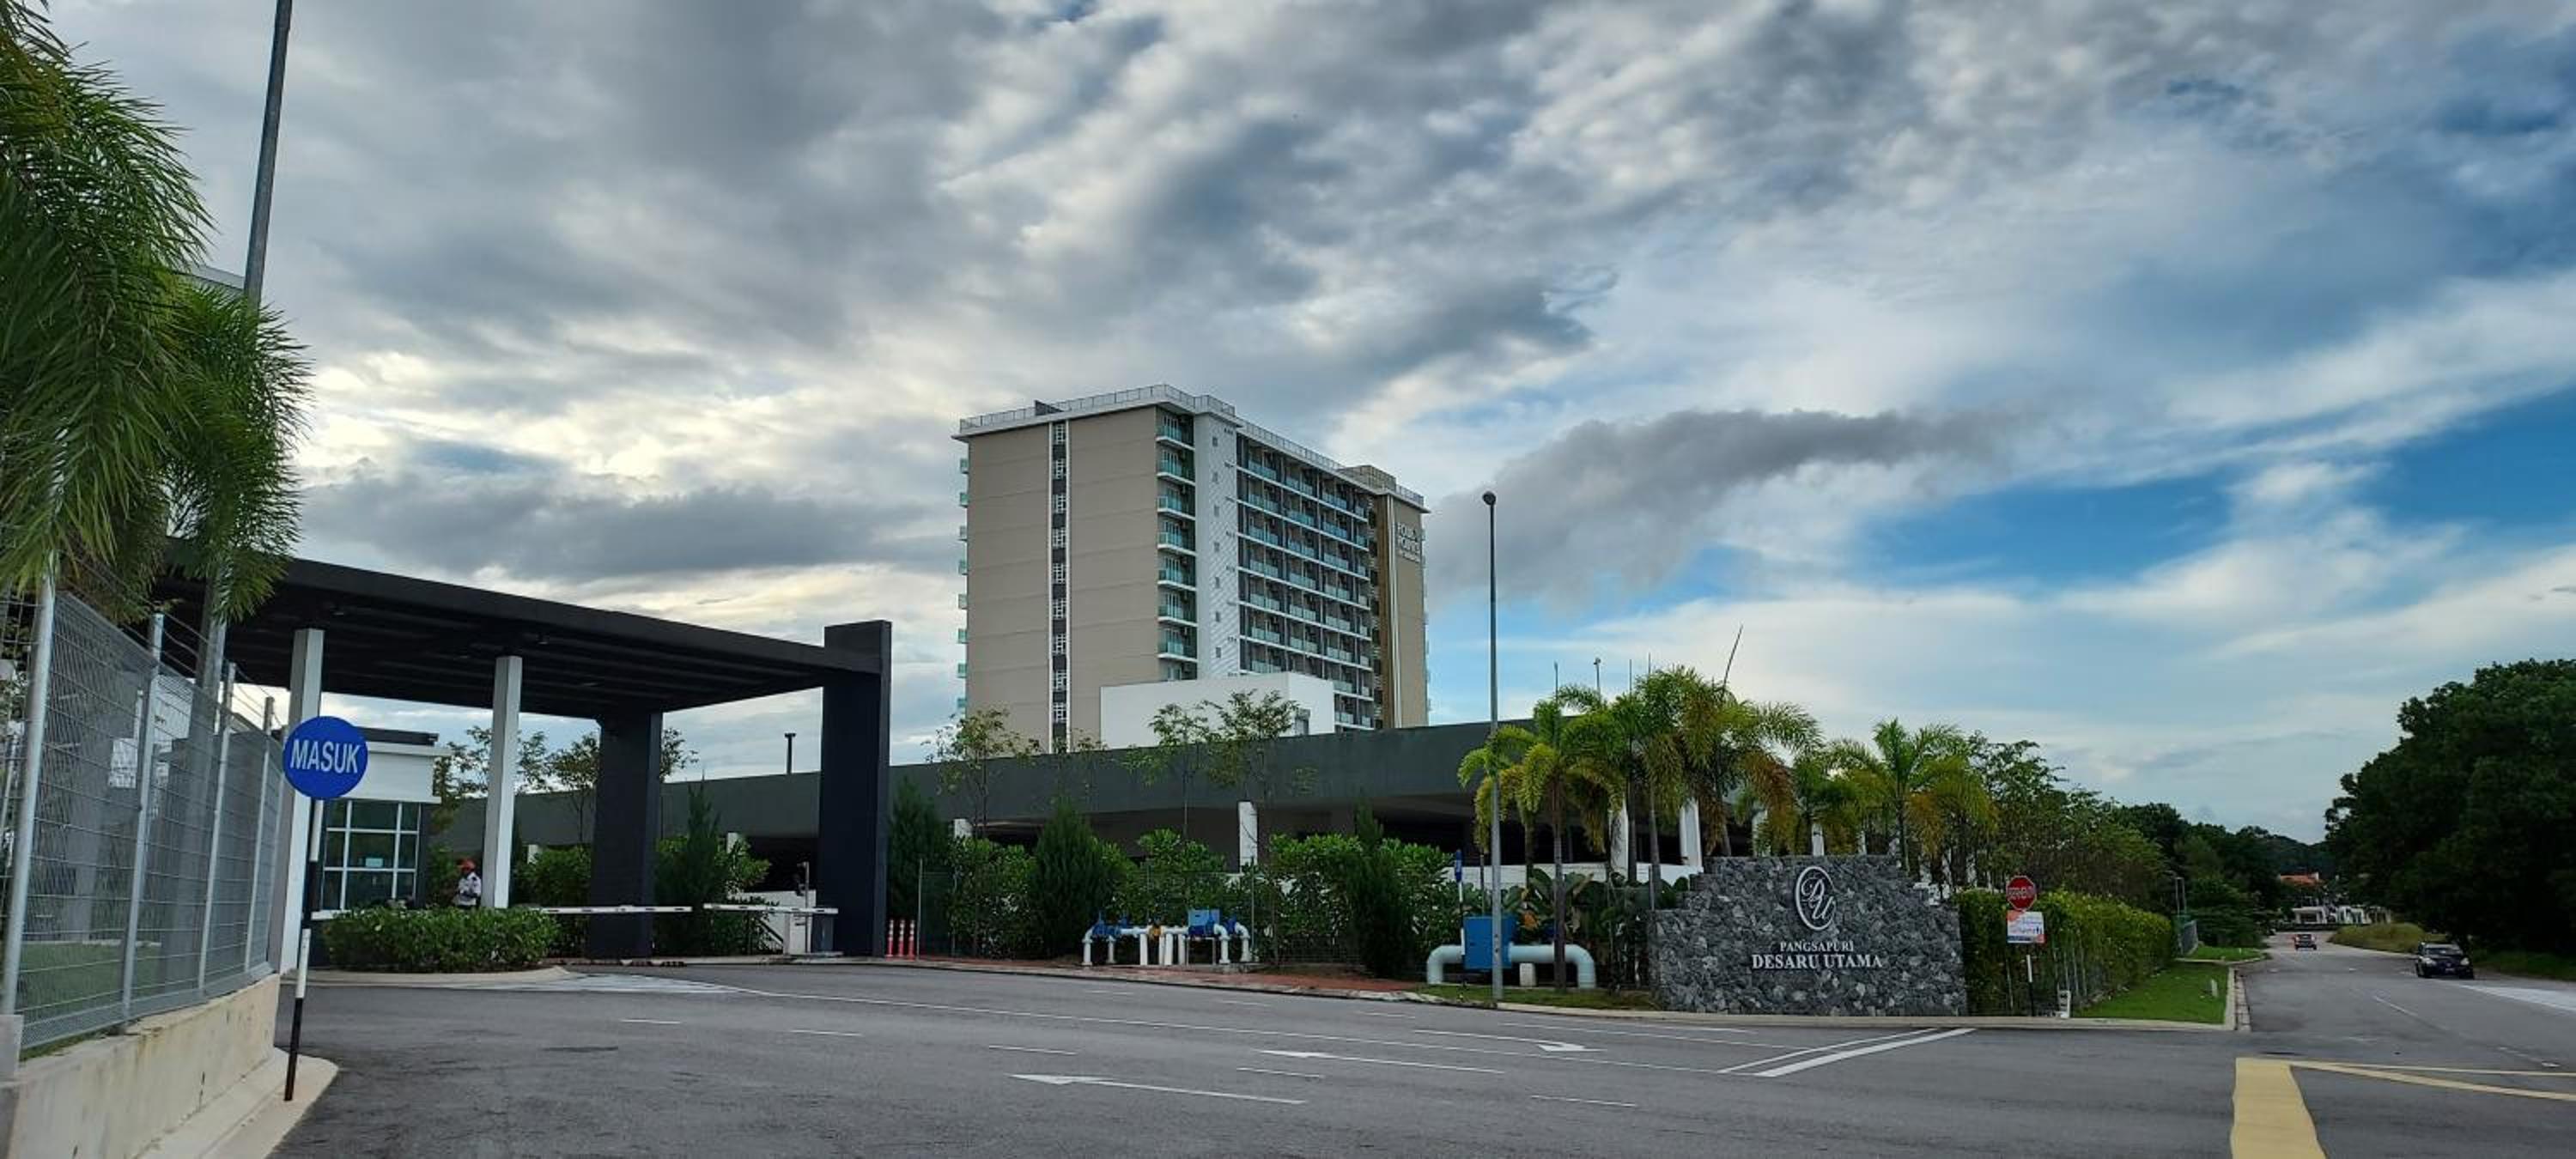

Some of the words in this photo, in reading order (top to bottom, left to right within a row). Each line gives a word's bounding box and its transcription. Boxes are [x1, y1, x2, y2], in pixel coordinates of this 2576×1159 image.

[290, 739, 360, 774] MASUK
[1780, 940, 1855, 952] PANGSAPURI
[1752, 954, 1820, 969] DESARU
[1824, 954, 1883, 968] UTAMA
